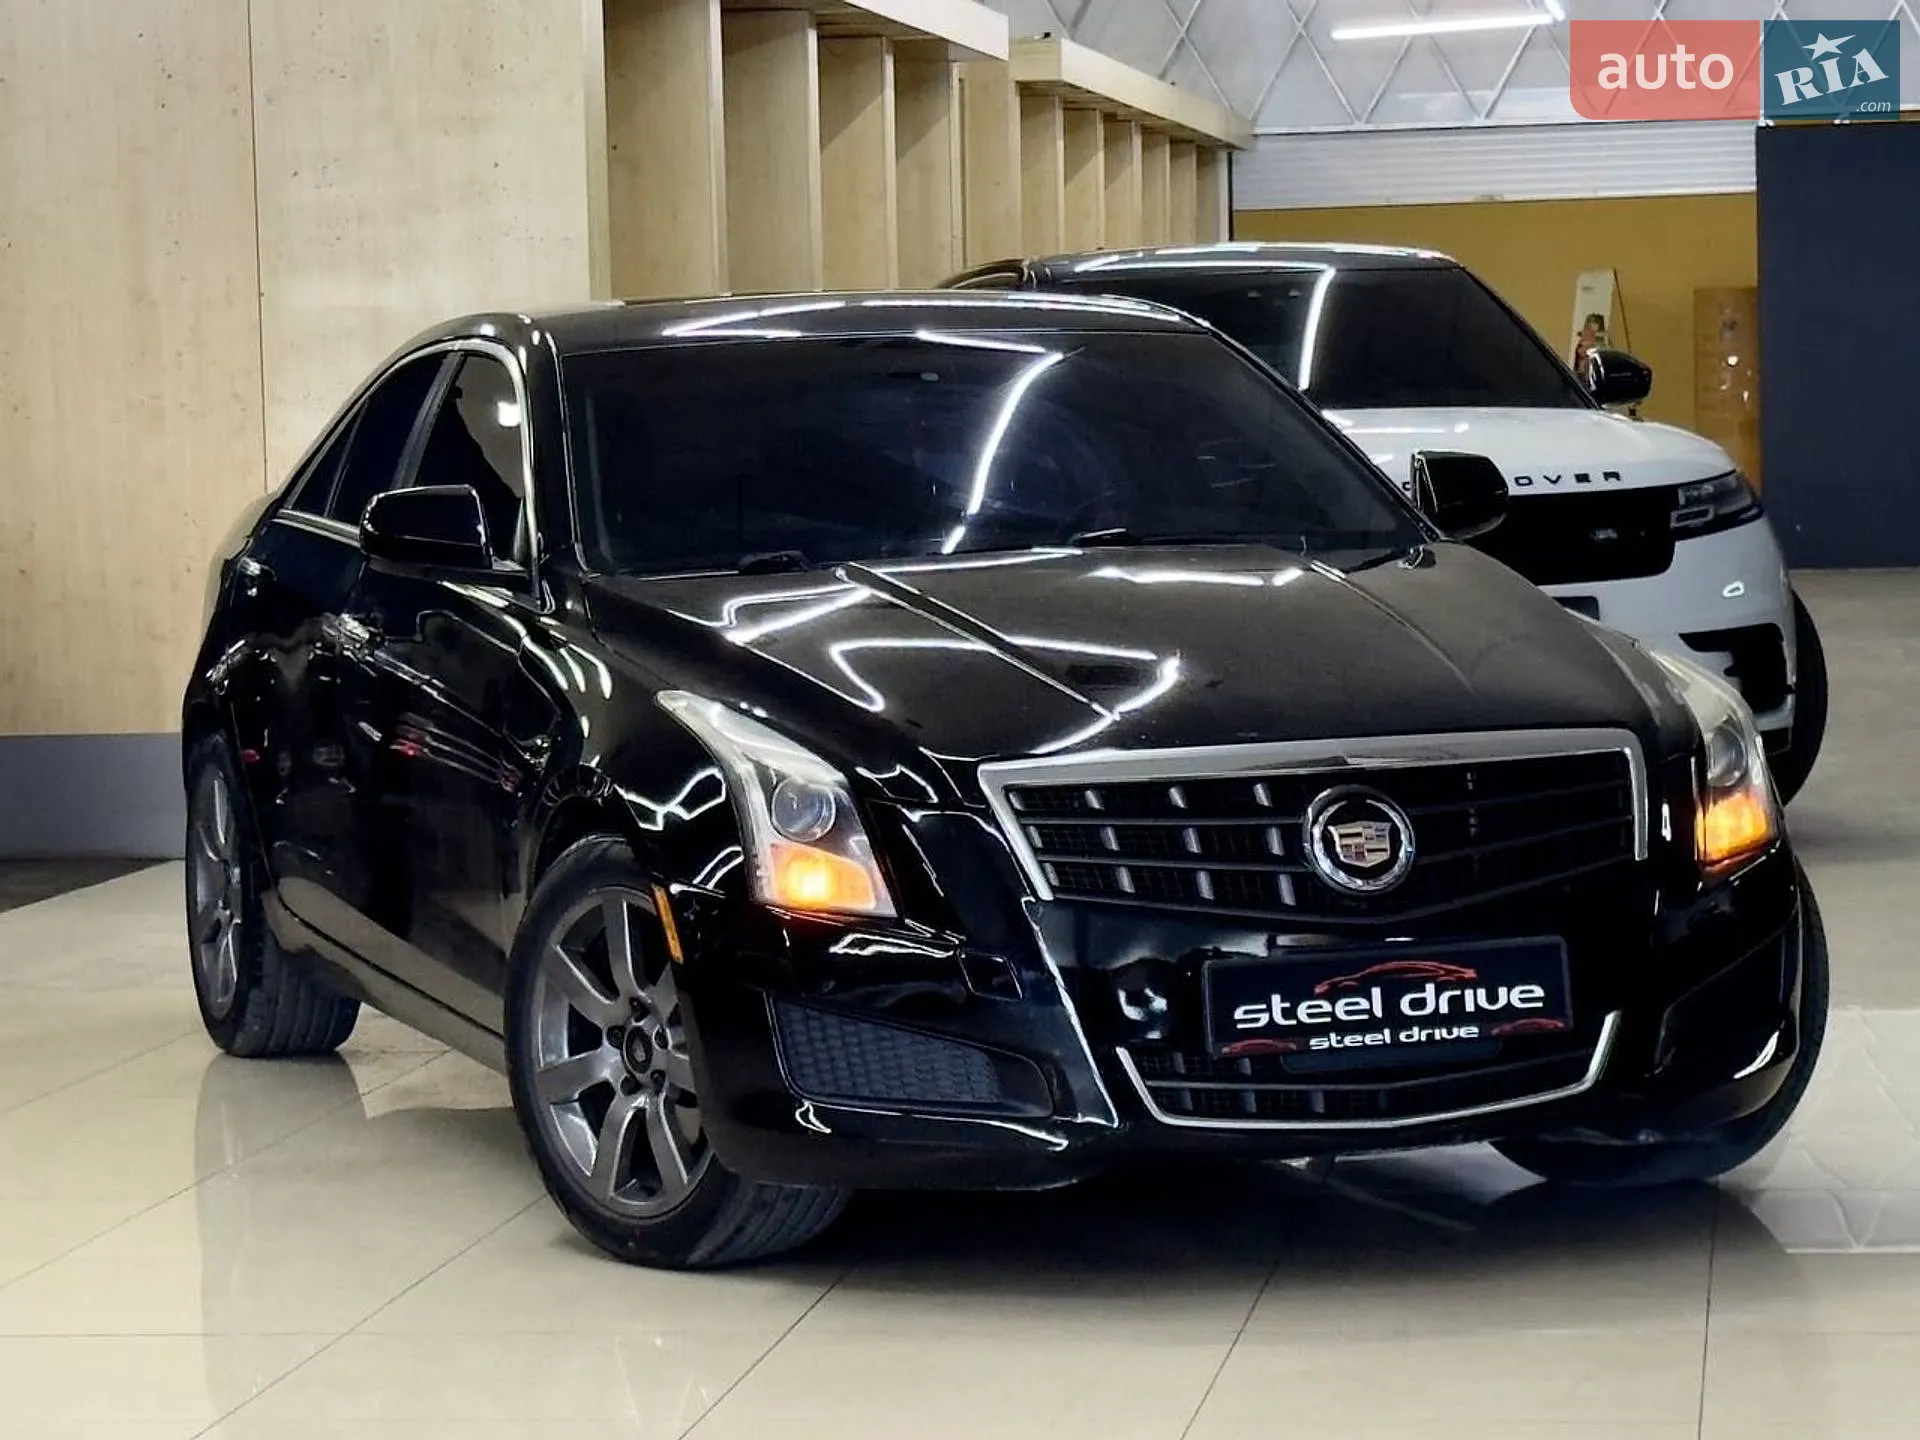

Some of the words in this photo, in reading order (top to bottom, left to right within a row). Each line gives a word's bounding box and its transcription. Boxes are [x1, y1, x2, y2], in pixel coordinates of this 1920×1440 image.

[1514, 471, 1621, 487] OVER
[1233, 986, 1382, 1029] steel
[1400, 982, 1545, 1016] drive
[1309, 1029, 1391, 1050] steel
[1399, 1025, 1479, 1043] drive
